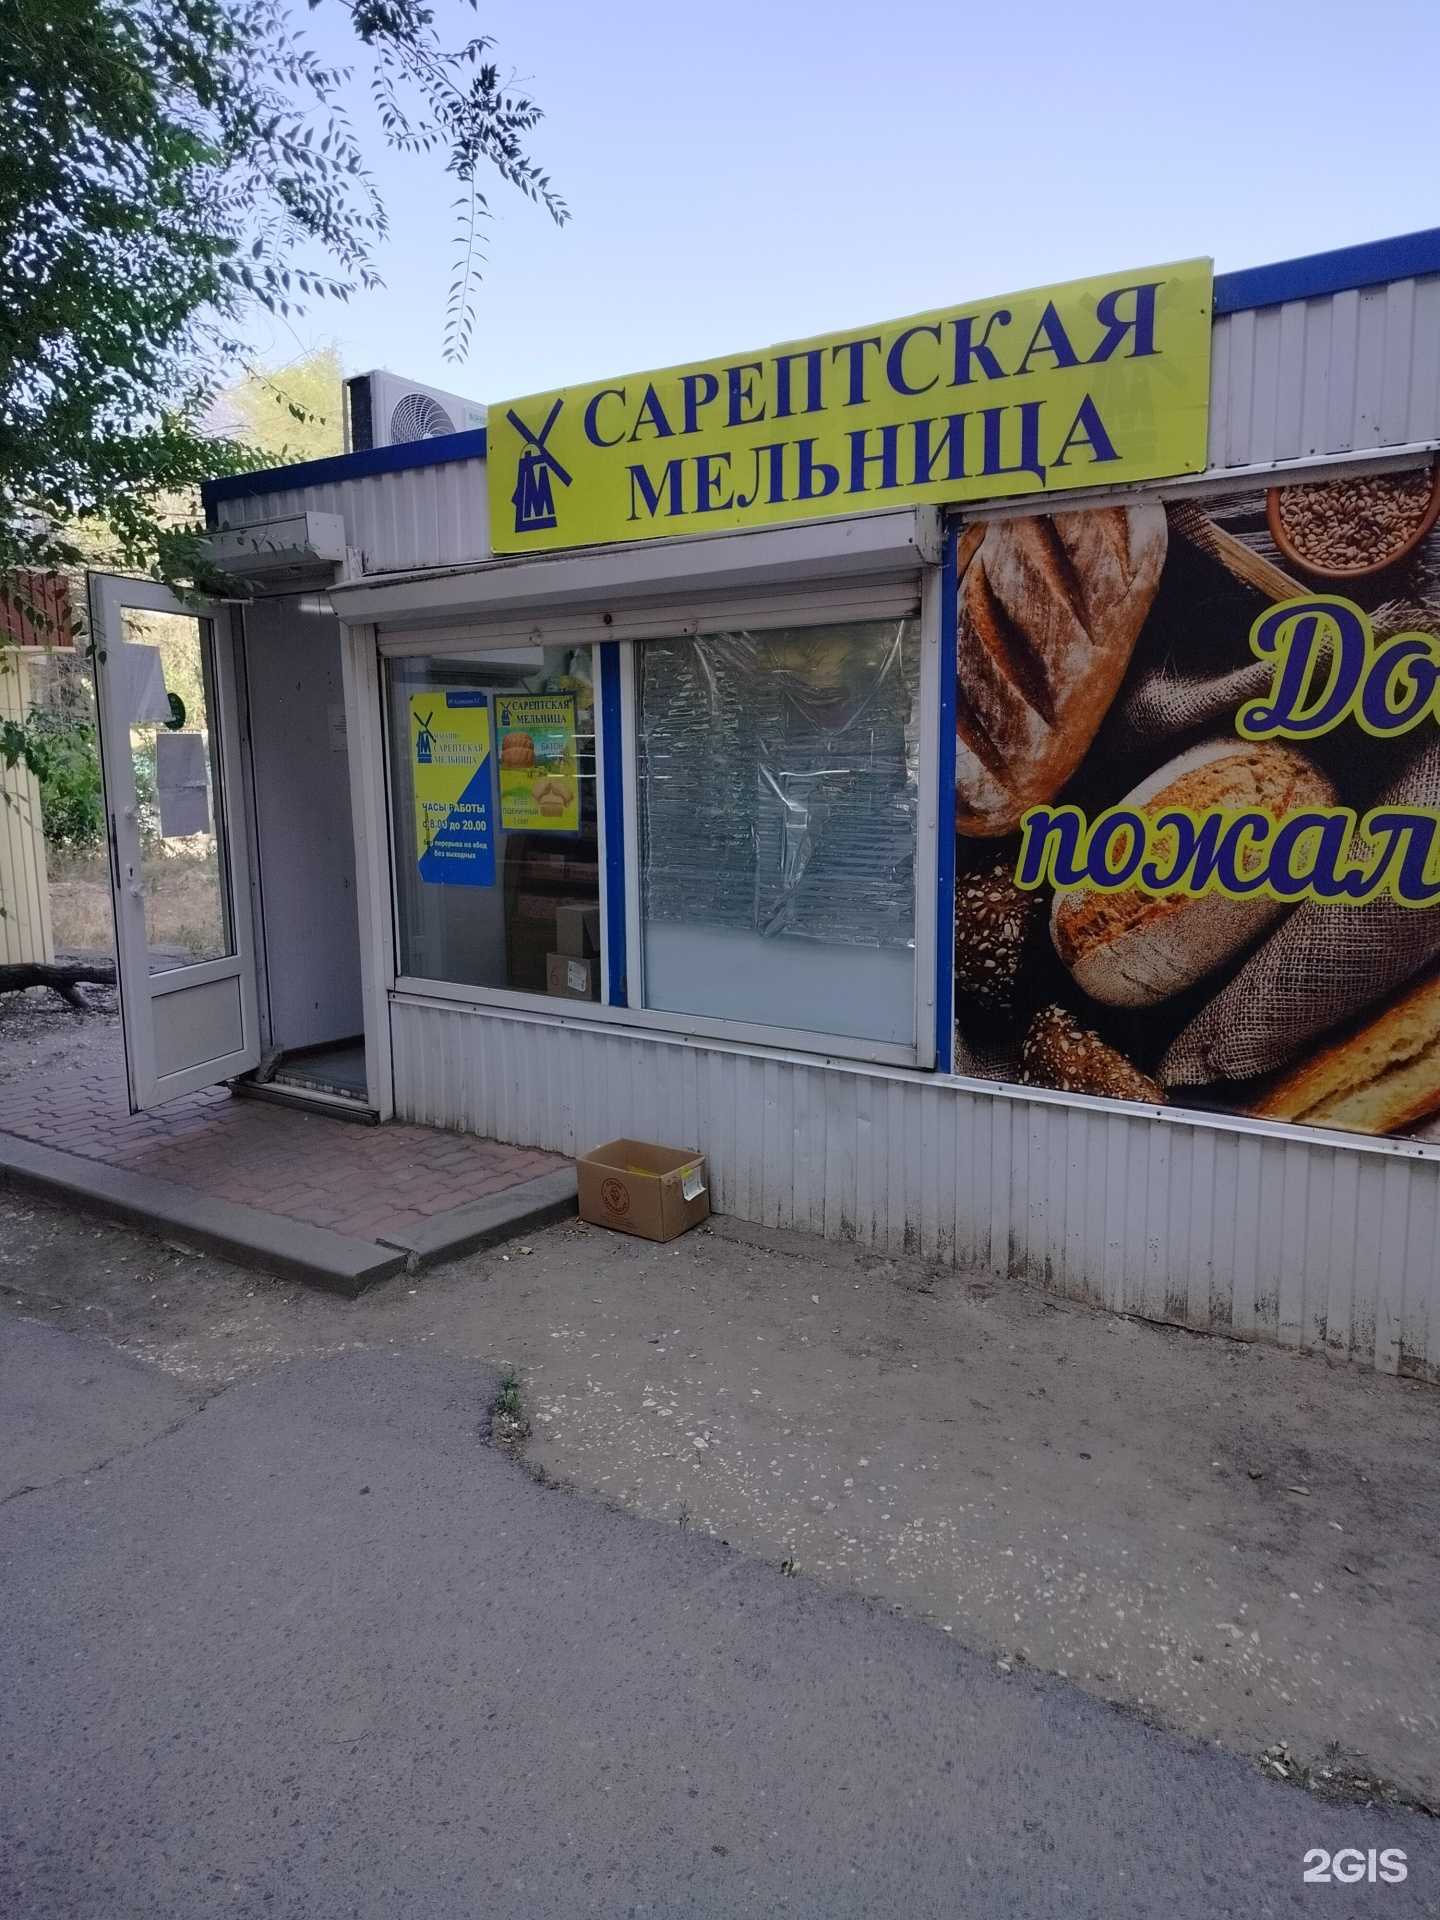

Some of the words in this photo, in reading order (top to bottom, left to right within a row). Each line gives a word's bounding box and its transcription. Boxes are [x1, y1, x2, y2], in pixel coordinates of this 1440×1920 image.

[583, 280, 1167, 449] САРЕПТСКАЯ
[625, 392, 1124, 522] МЕЛЬНИЦА
[1238, 597, 1440, 737] До
[512, 699, 569, 711] САРЕПТСКАЯ
[516, 713, 567, 725] МЕЛЬНИЦА
[422, 802, 448, 813] ЧАСЫ
[449, 802, 486, 814] РАБОТЫ
[450, 822, 461, 832] до
[462, 820, 487, 832] 20.00
